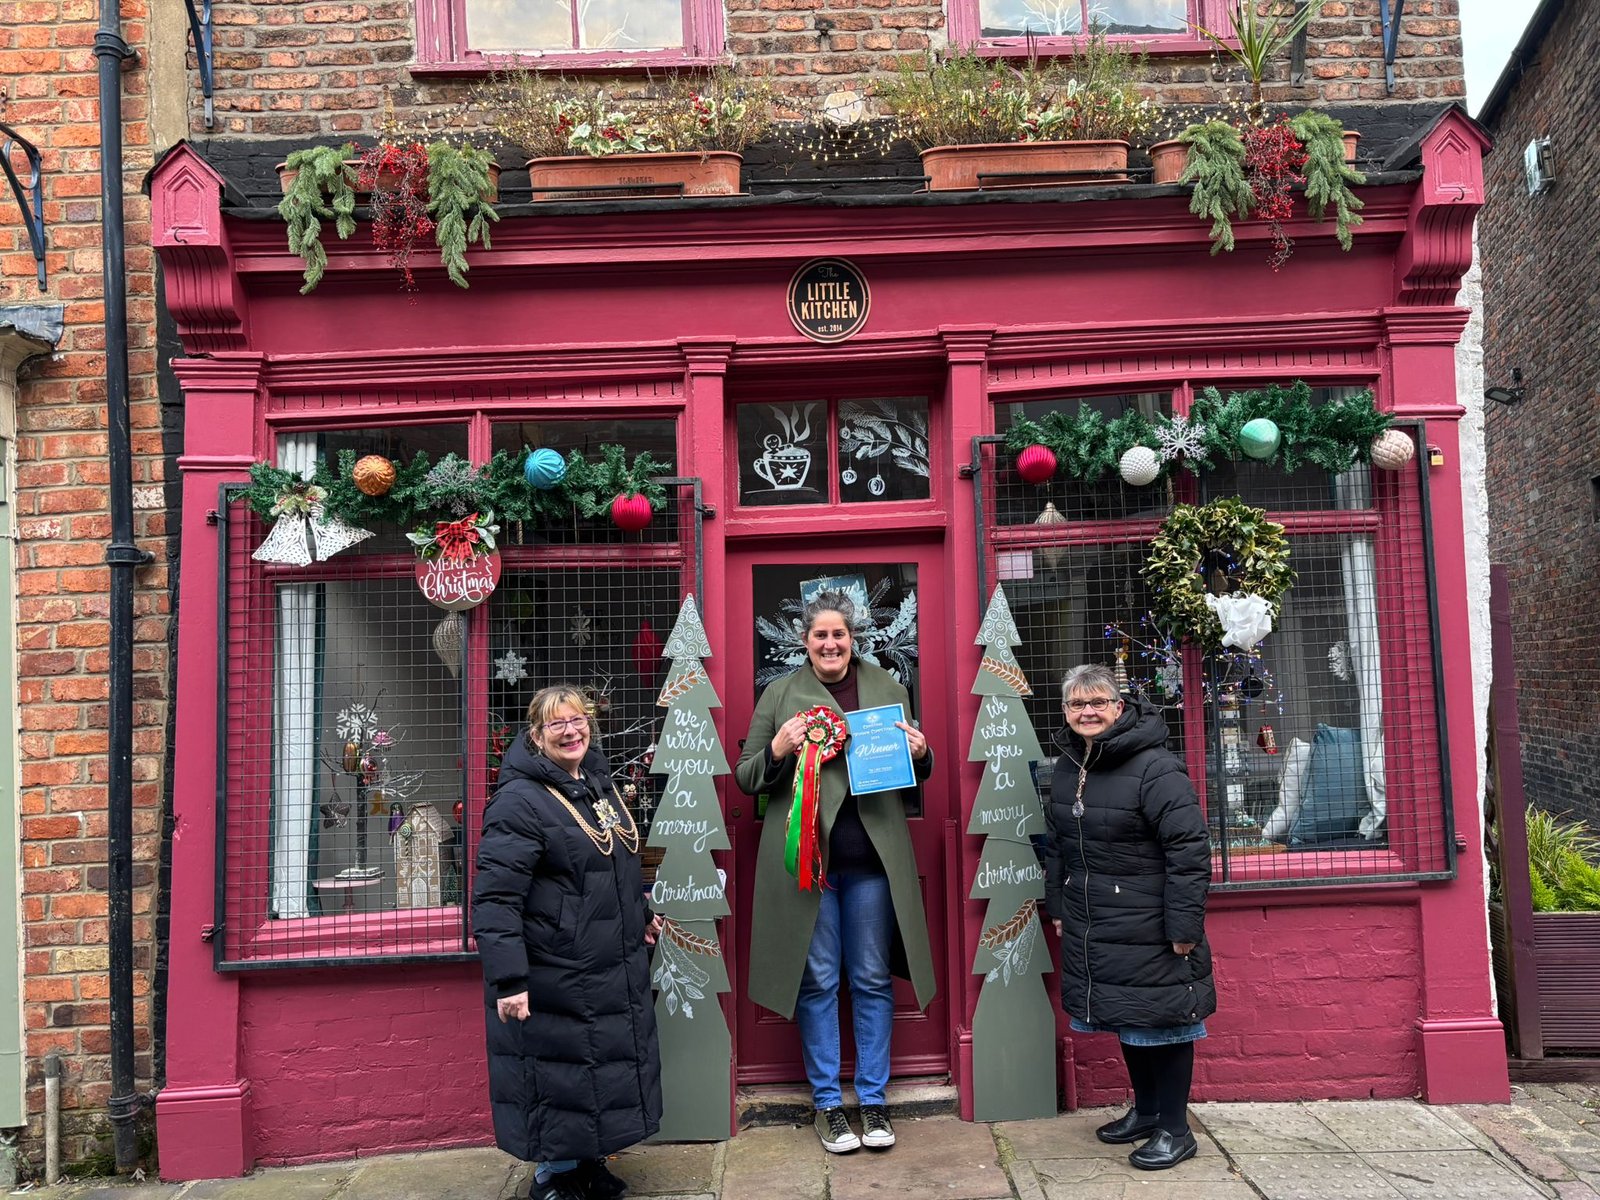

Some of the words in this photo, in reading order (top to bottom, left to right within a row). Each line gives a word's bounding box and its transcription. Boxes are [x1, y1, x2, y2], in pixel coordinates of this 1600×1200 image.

[818, 266, 840, 278] The
[807, 282, 850, 301] LITTLE
[801, 301, 858, 320] KITCHEN
[817, 325, 829, 333] est.
[829, 324, 843, 332] 2014
[419, 570, 496, 604] Christmas
[665, 719, 715, 752] wish
[980, 718, 1017, 740] wish
[855, 742, 901, 758] Winner
[984, 743, 1023, 774] you
[664, 758, 715, 795] you
[993, 771, 1016, 791] a
[674, 790, 697, 808] a
[976, 804, 1033, 838] merry
[656, 819, 719, 854] merry
